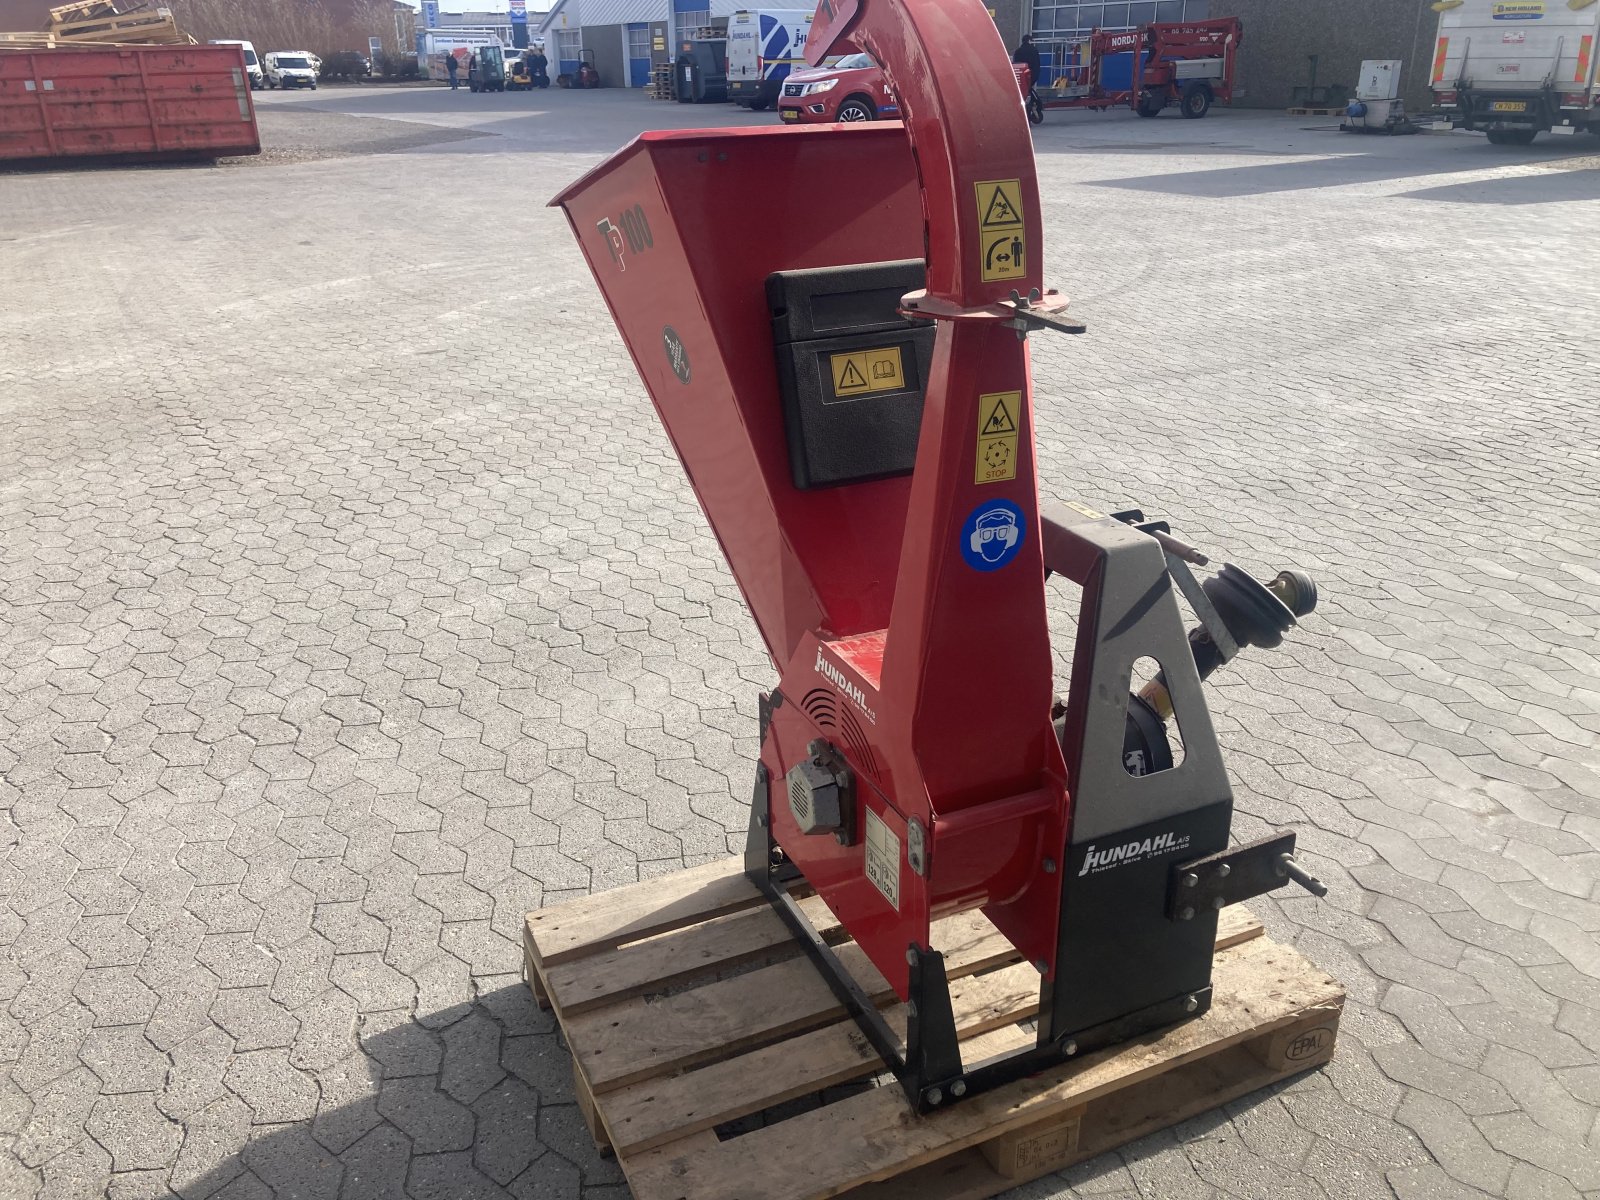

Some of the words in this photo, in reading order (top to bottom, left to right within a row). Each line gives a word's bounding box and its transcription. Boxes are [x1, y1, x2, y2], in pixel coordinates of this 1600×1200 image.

[1111, 33, 1149, 46] NORDJK
[619, 204, 654, 256] 100
[985, 469, 1007, 478] STOP
[1177, 835, 1190, 845] A/S
